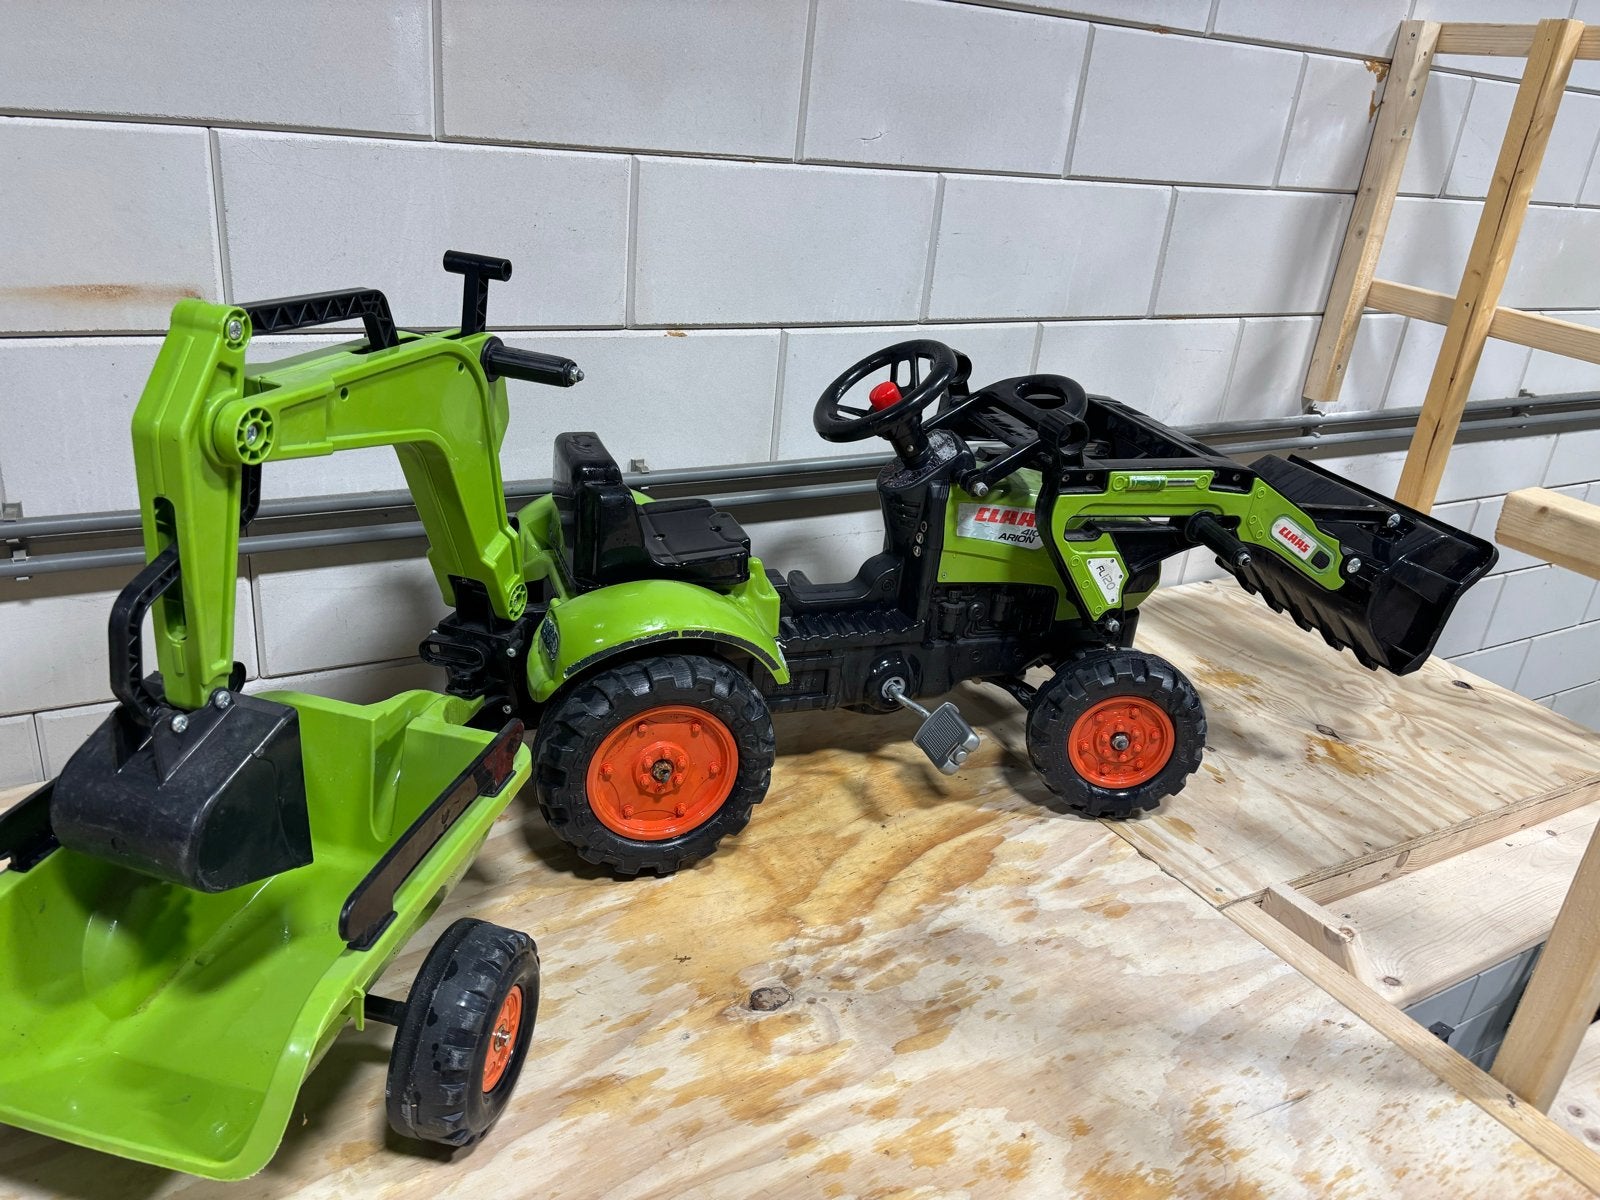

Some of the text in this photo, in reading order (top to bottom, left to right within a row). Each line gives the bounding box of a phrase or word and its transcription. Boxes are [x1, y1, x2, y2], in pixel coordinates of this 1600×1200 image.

[974, 507, 1037, 527] CLAA
[998, 532, 1035, 544] ARION
[1279, 526, 1310, 554] CLAAS
